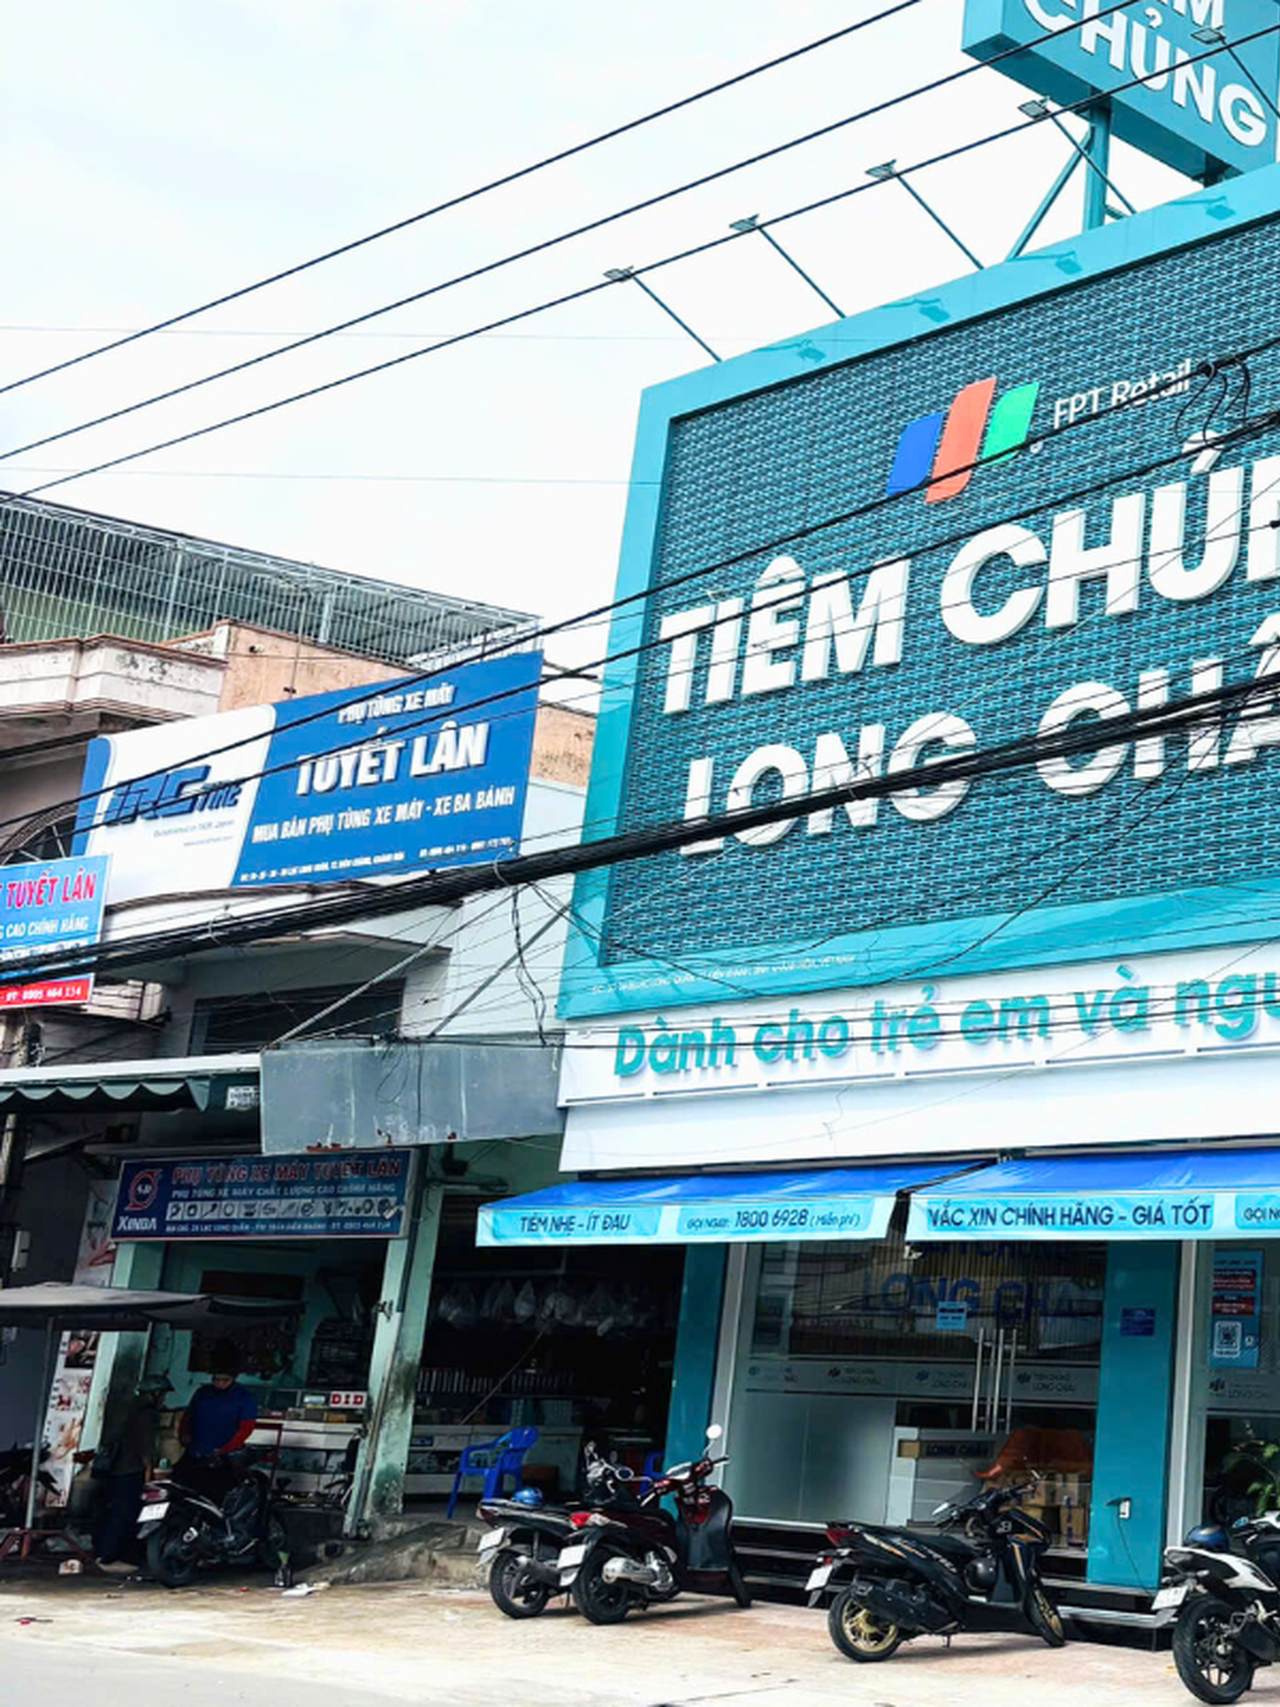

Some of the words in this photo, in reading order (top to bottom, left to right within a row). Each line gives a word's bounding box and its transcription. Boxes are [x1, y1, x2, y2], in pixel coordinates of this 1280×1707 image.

[1053, 386, 1107, 430] FPT
[1111, 358, 1191, 410] Retail
[658, 555, 909, 714] TIÊM
[404, 691, 424, 711] XE
[425, 683, 456, 708] MÁY
[296, 726, 405, 796] TUYẾT
[410, 720, 490, 777] LÂN
[679, 712, 976, 856] LONG
[252, 820, 279, 844] MUA
[281, 815, 306, 839] BÁN
[308, 816, 334, 837] PHỤ
[337, 805, 371, 829] TÙNG
[374, 806, 392, 824] XE
[394, 798, 424, 822] MÁY
[433, 797, 452, 816] XE
[453, 795, 471, 814] BA
[474, 785, 516, 808] BÁNH
[7, 868, 58, 909] TUYẾT
[61, 867, 97, 903] LÂN
[5, 922, 26, 938] CAO
[614, 1015, 738, 1077] Dành
[752, 1008, 850, 1062] cho
[869, 984, 941, 1054] trẻ
[960, 992, 1052, 1044] em
[1074, 963, 1151, 1037] và
[735, 1209, 768, 1229] 1800
[771, 1207, 809, 1228] 6928
[927, 1198, 965, 1229] VẮC
[966, 1201, 1001, 1228] XIN
[1002, 1197, 1057, 1227] CHÍNH
[1059, 1196, 1114, 1227] HÃNG
[1131, 1197, 1166, 1226] GIÁ
[1171, 1195, 1211, 1227] TỐT
[1244, 1207, 1266, 1224] GỌI
[331, 1393, 364, 1406] DID
